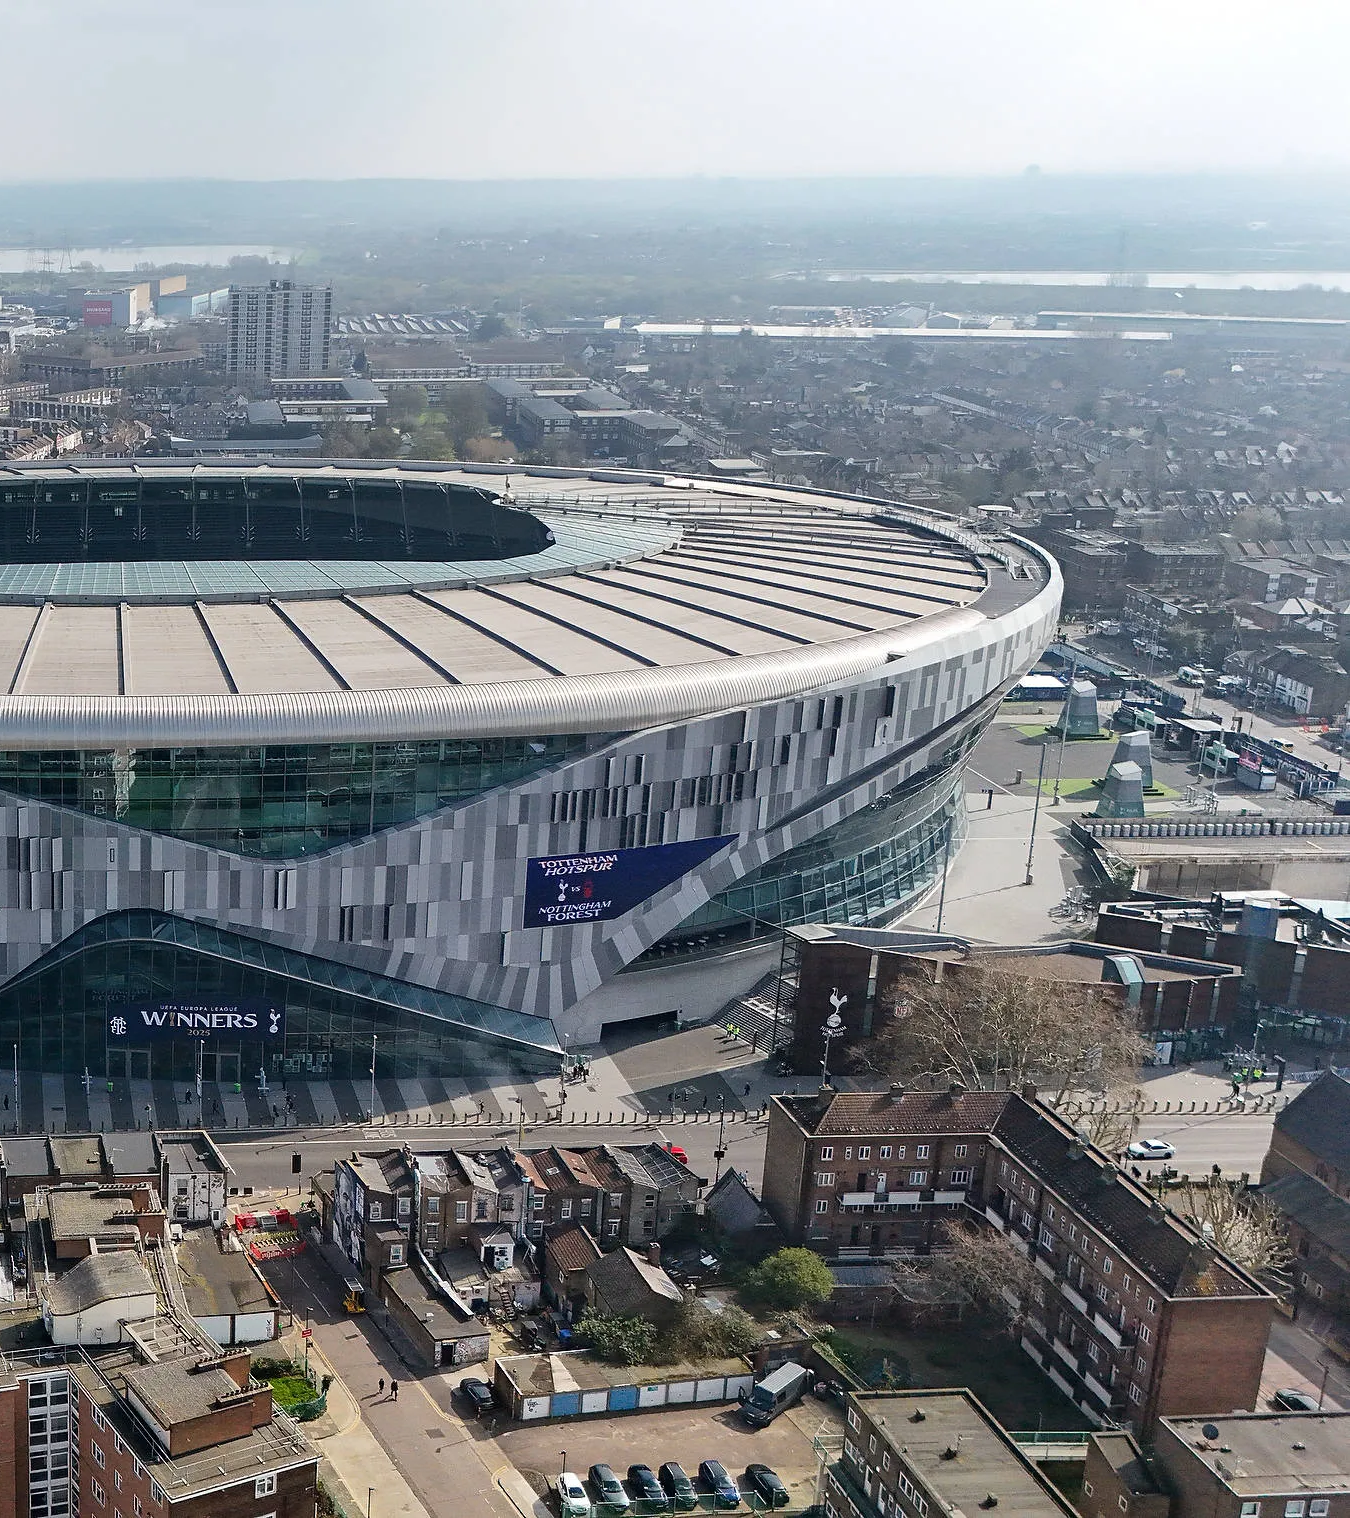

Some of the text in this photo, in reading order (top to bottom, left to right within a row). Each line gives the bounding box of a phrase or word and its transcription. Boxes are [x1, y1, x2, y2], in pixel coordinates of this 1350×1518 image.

[538, 854, 618, 869] TOTTENHAM
[544, 862, 613, 876] HOTSPUR
[538, 900, 612, 914] NOTTINGHAM
[547, 908, 602, 921] FOREST
[140, 1010, 258, 1028] WINNERS
[187, 1028, 211, 1037] 2025
